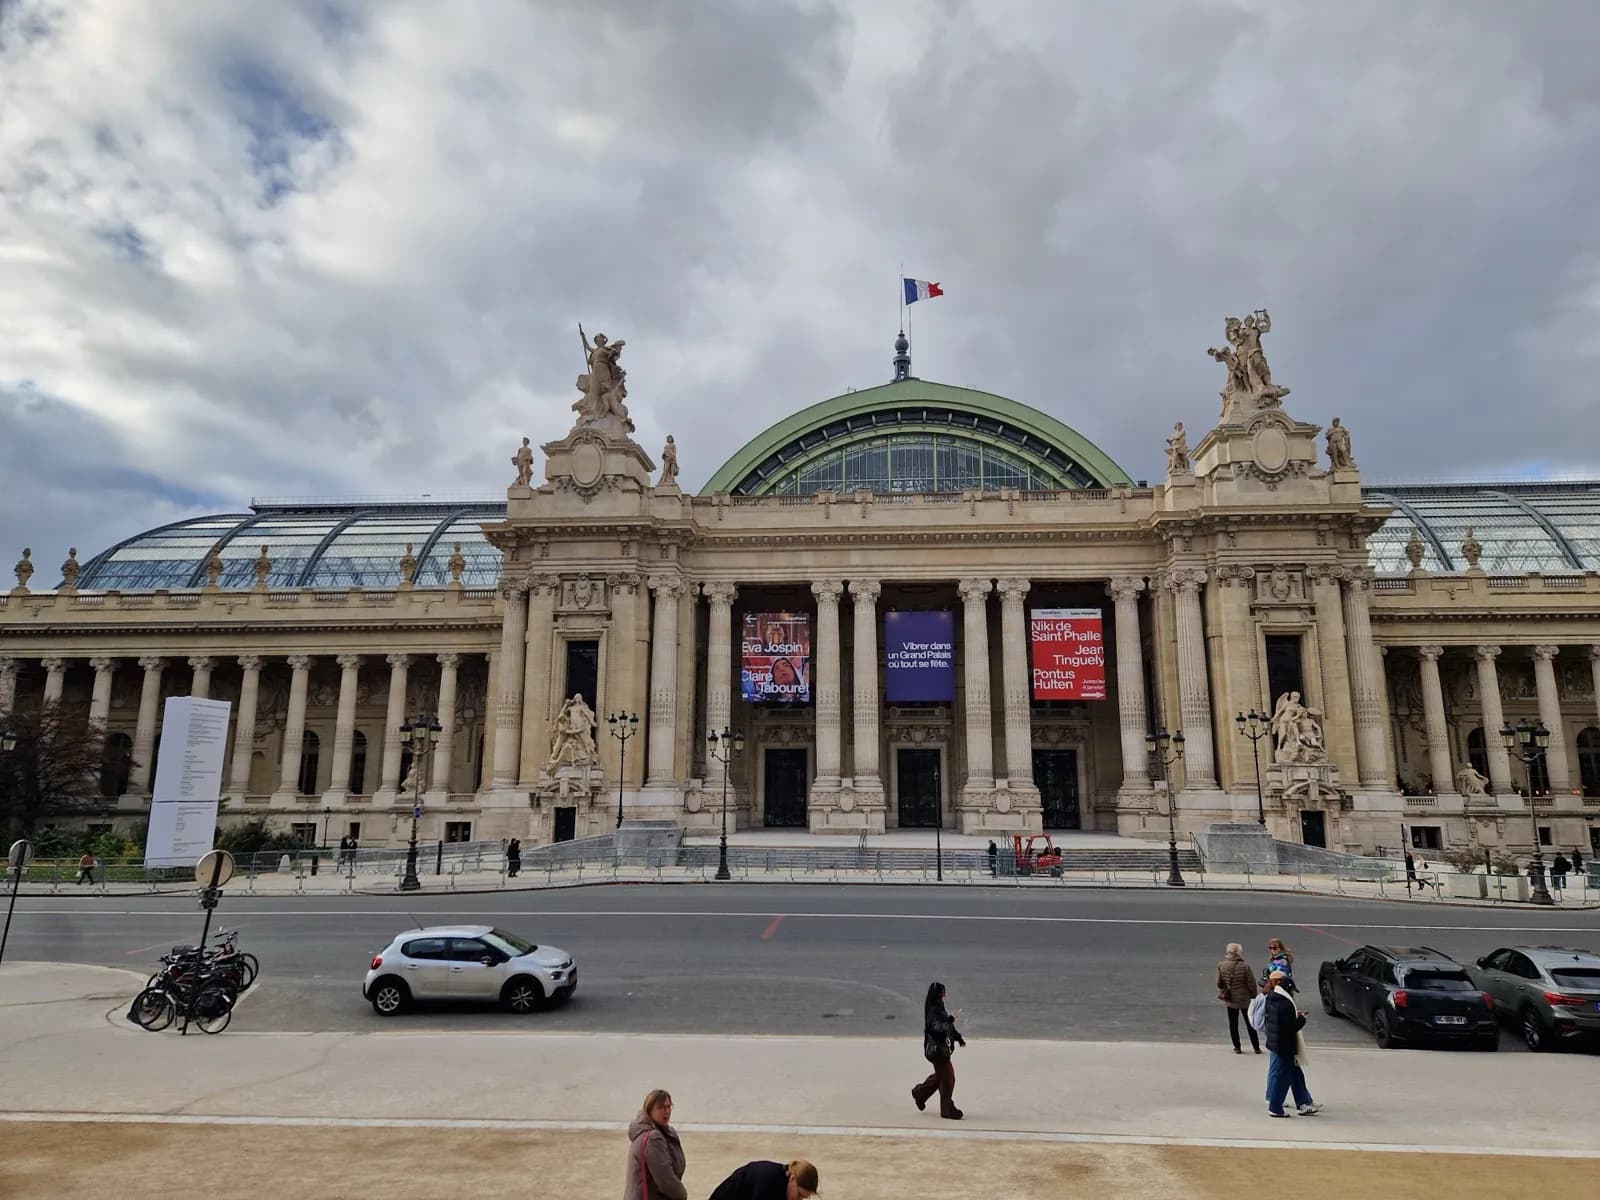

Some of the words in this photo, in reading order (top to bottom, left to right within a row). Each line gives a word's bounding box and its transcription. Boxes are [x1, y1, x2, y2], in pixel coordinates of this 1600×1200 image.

[1032, 621, 1054, 631] Niki
[1055, 621, 1072, 631] de
[1032, 631, 1062, 641] Saint
[1064, 630, 1101, 641] Phalle
[742, 642, 761, 653] Eva
[764, 641, 803, 654] Jospin
[902, 642, 929, 650] Vibrer
[930, 642, 951, 650] dans
[1075, 645, 1104, 655] Jean
[900, 651, 926, 659] Grand
[927, 651, 952, 659] Palais
[888, 660, 899, 668] où
[901, 660, 918, 668] tout
[1053, 655, 1105, 667] Tinguely
[742, 670, 773, 681] Claire
[1033, 669, 1075, 679] Pontus
[758, 682, 809, 693] Tabouret
[1033, 679, 1073, 689] Hulten
